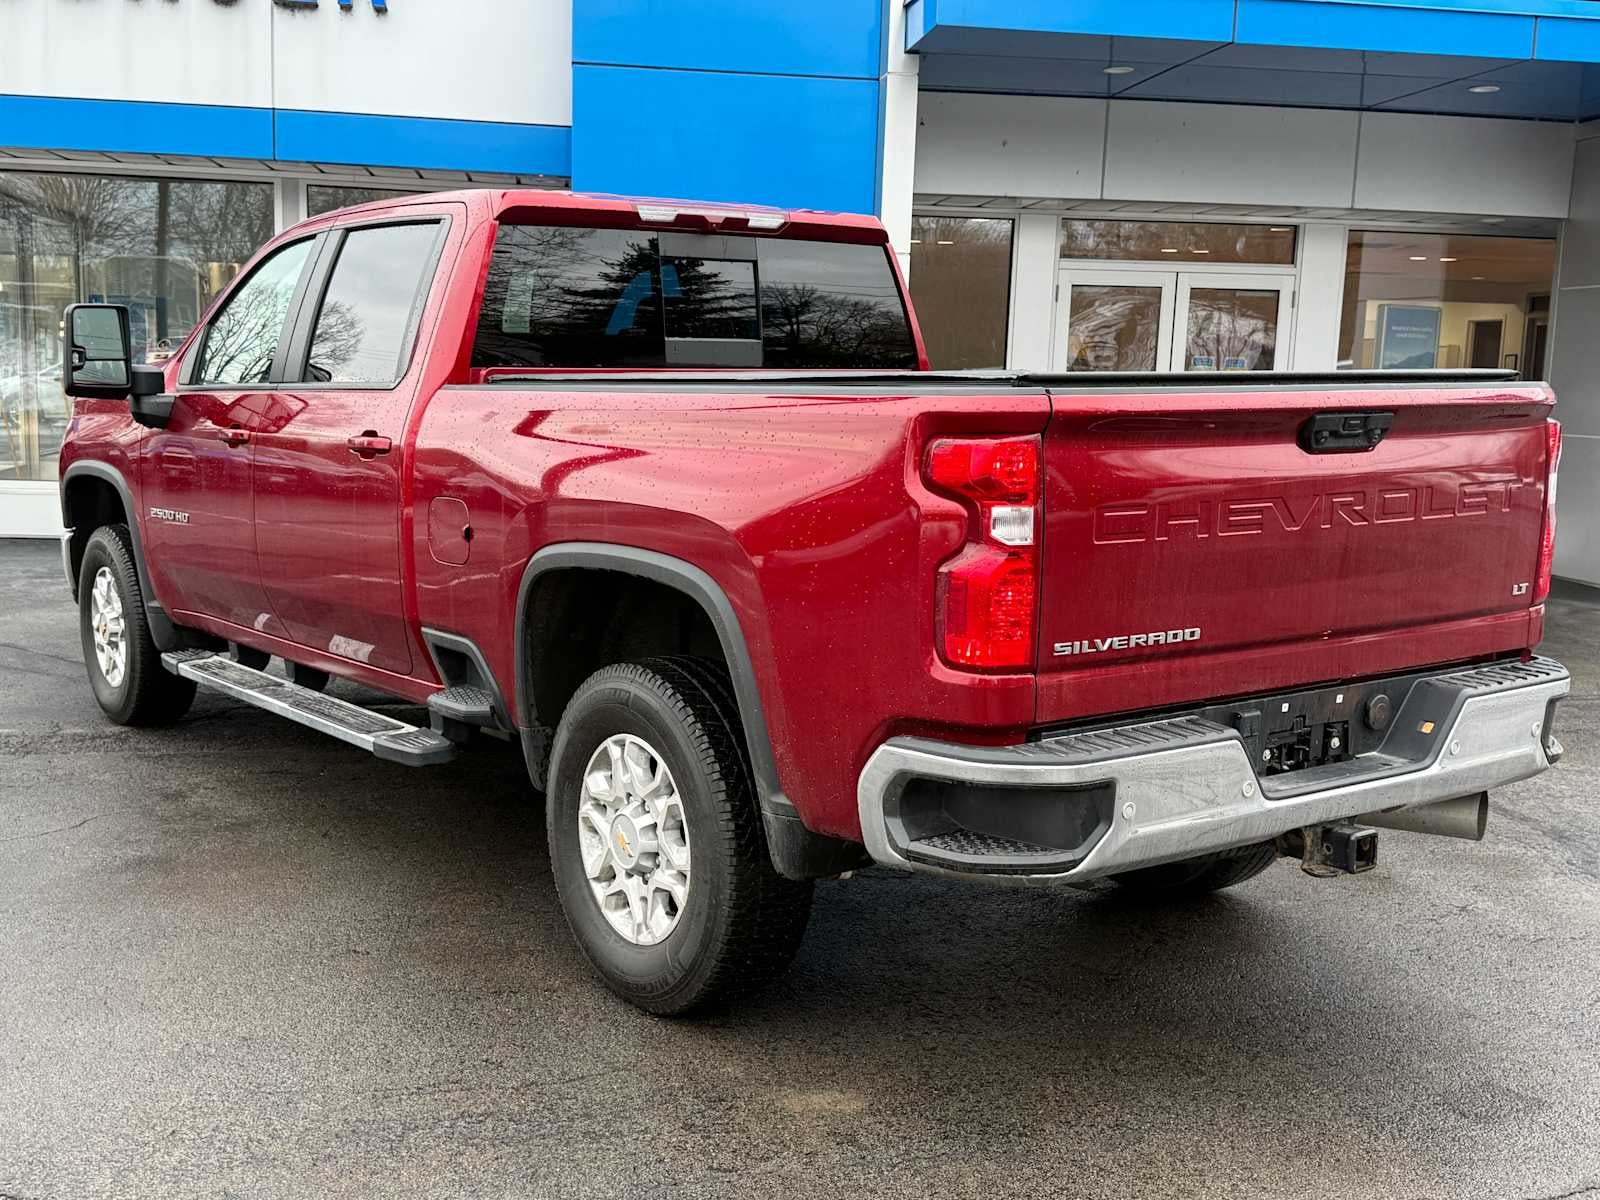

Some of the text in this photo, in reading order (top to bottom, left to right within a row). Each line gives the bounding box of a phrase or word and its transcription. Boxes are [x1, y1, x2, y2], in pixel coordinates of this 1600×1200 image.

[1093, 479, 1524, 545] CHEVROLET
[1512, 582, 1529, 596] LT
[1053, 627, 1201, 656] SILVERADO
